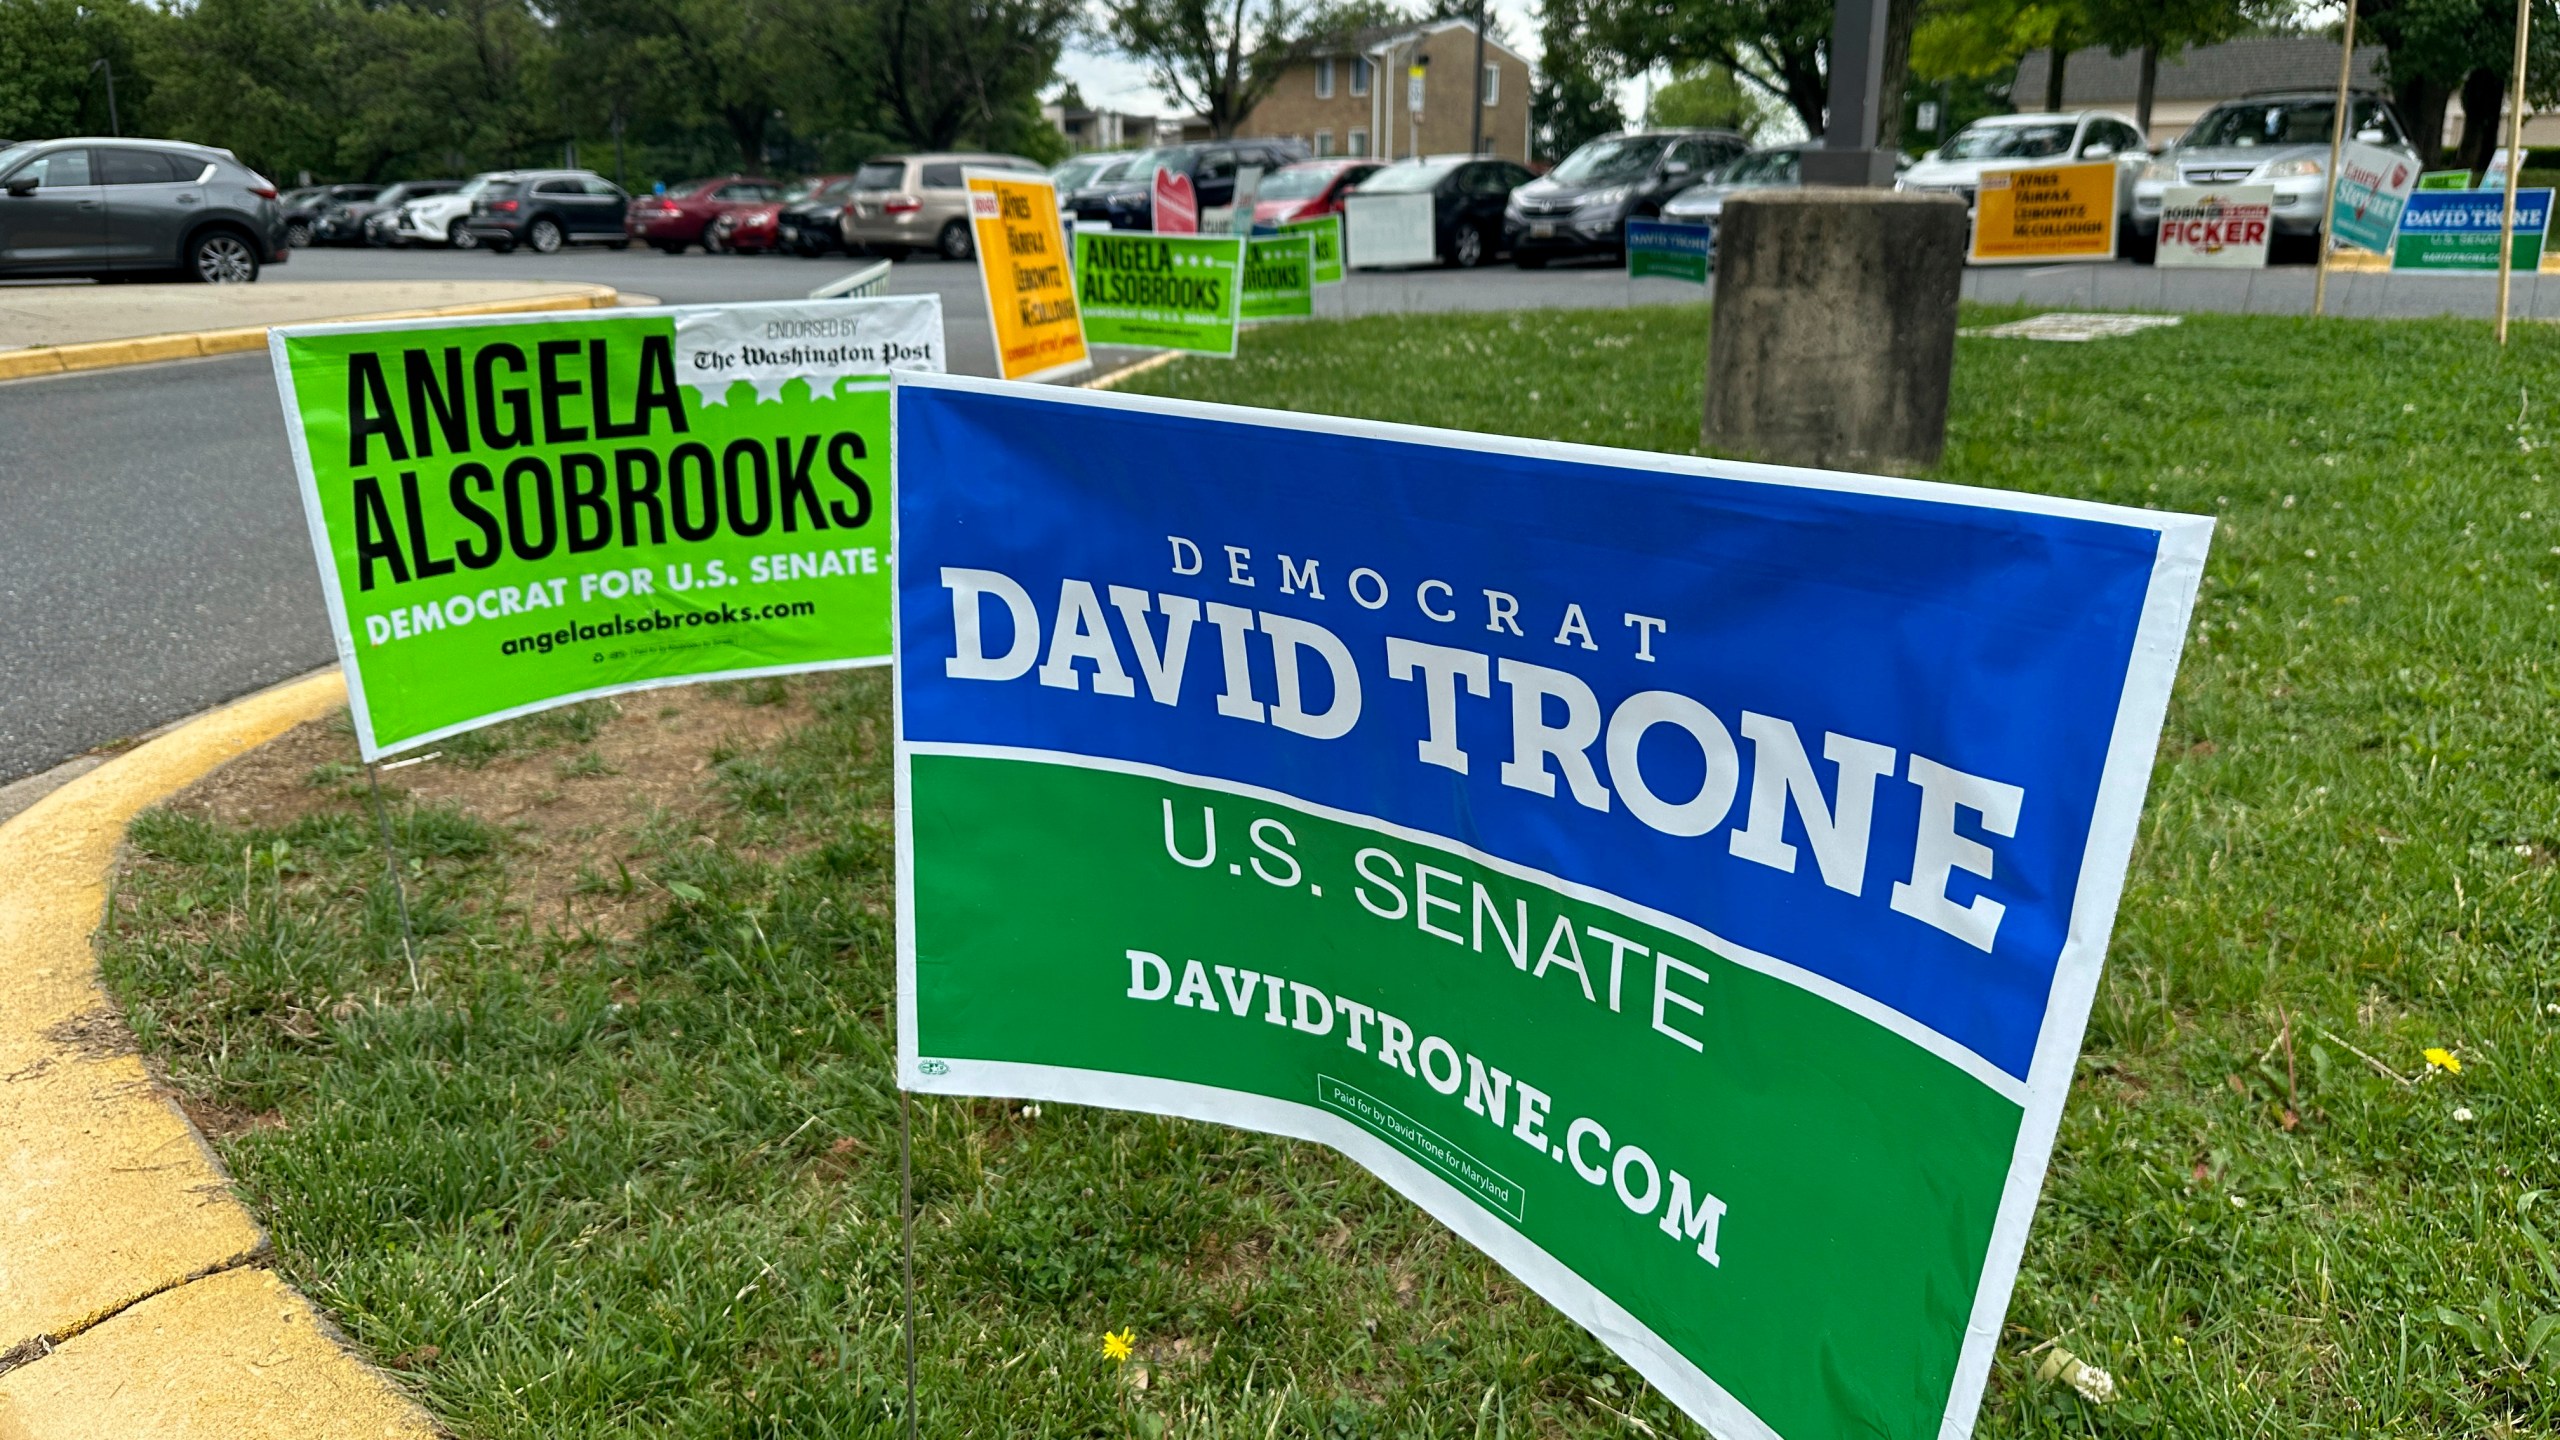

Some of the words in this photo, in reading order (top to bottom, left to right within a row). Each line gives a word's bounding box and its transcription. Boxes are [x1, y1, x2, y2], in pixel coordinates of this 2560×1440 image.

[2160, 220, 2266, 245] FICKER
[2163, 206, 2205, 220] ROBIN
[2404, 209, 2469, 227] DAVID
[1082, 271, 1222, 312] ALSOBROOKS
[1086, 239, 1174, 272] ANGELA
[694, 351, 735, 371] The
[742, 345, 875, 371] Washington
[881, 342, 932, 364] Post
[767, 319, 837, 340] ENDORSED
[841, 317, 859, 337] BY
[349, 335, 690, 467] ANGELA
[356, 431, 872, 592] ALSOBROOKS
[366, 578, 566, 645] DEMOCRAT
[581, 566, 655, 602] FOR
[667, 560, 737, 593] U.S.
[750, 548, 878, 583] SENATE
[501, 600, 815, 656] angelaalsobrooks.com
[1167, 535, 1667, 662] DEMOCRAT
[940, 566, 1362, 740] DAVID
[1386, 636, 2025, 954] TRONE
[1162, 798, 1322, 897] U.S.
[1354, 848, 1710, 1054] SENATE
[1125, 949, 1727, 1268] DAVIDTRONE.COM
[1334, 1087, 1356, 1107] Paid
[1357, 1099, 1373, 1115] for
[1373, 1107, 1386, 1124] by
[1387, 1115, 1415, 1140] David
[1416, 1131, 1444, 1160] Trone
[1445, 1151, 1461, 1169] for
[1461, 1162, 1509, 1202] Maryland
